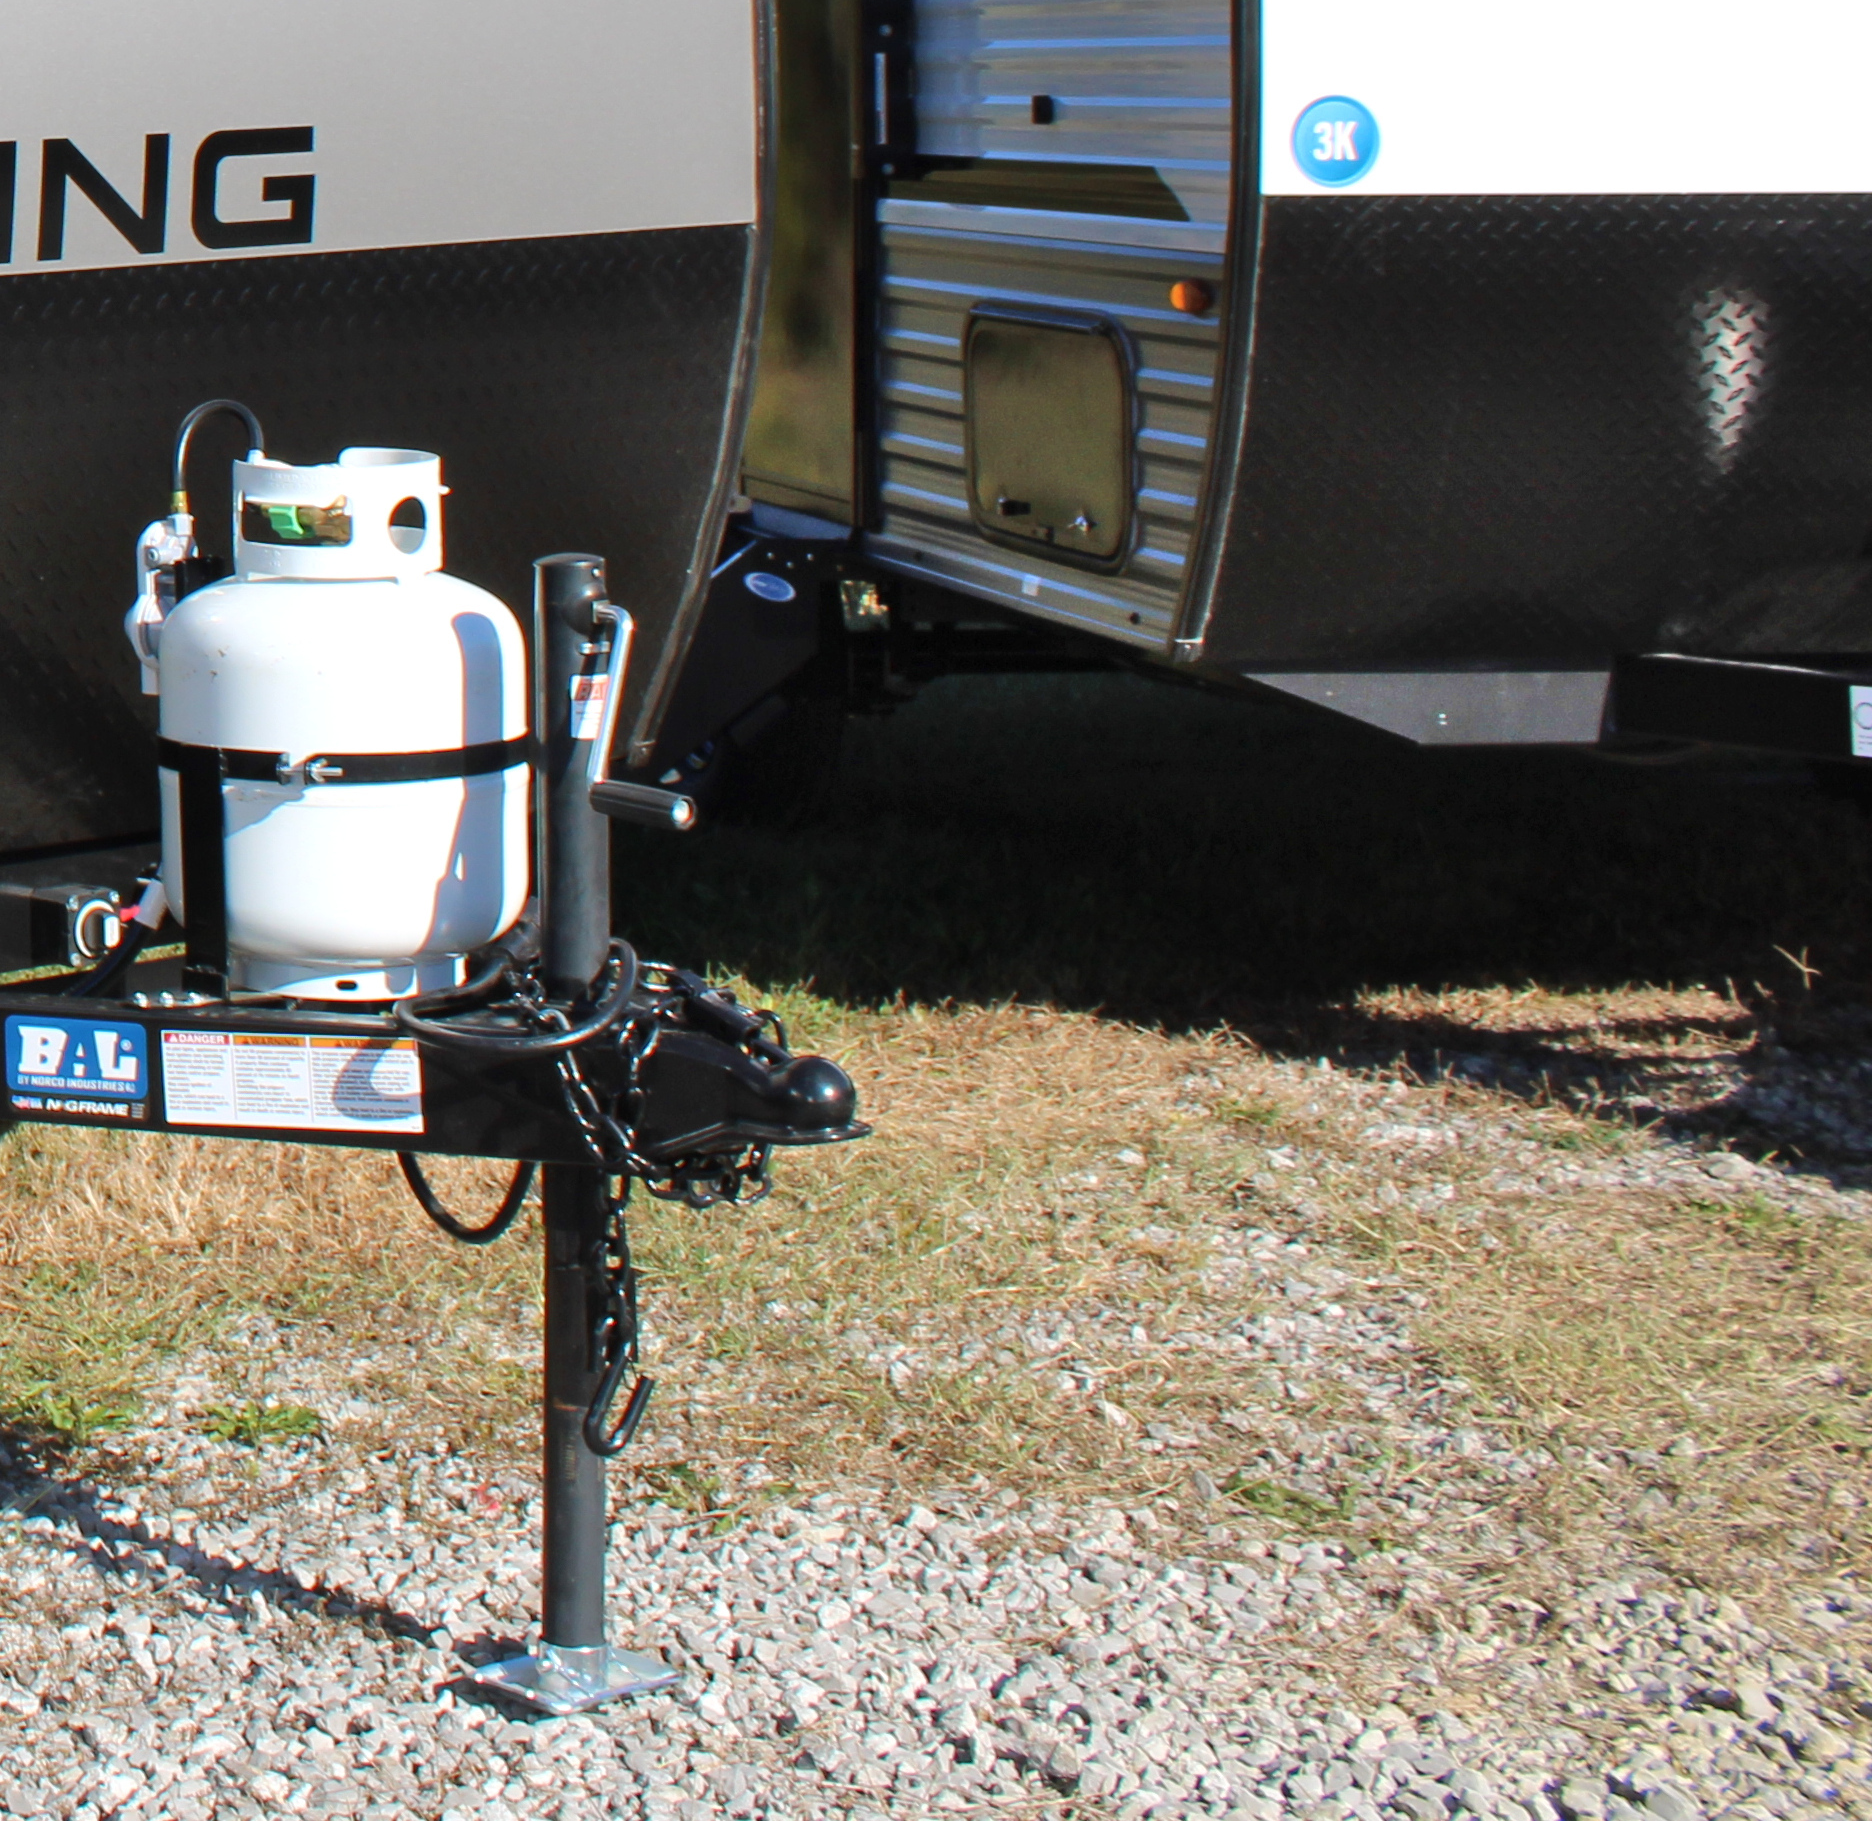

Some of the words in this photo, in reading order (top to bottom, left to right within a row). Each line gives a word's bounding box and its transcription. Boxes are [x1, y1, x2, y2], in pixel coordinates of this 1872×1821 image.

[1312, 120, 1358, 162] 3K
[17, 1024, 139, 1081] BAL
[179, 1033, 225, 1045] DANGER
[17, 1074, 29, 1085] BY
[31, 1075, 65, 1088] NORCO
[67, 1077, 125, 1092] INDUSTRIES
